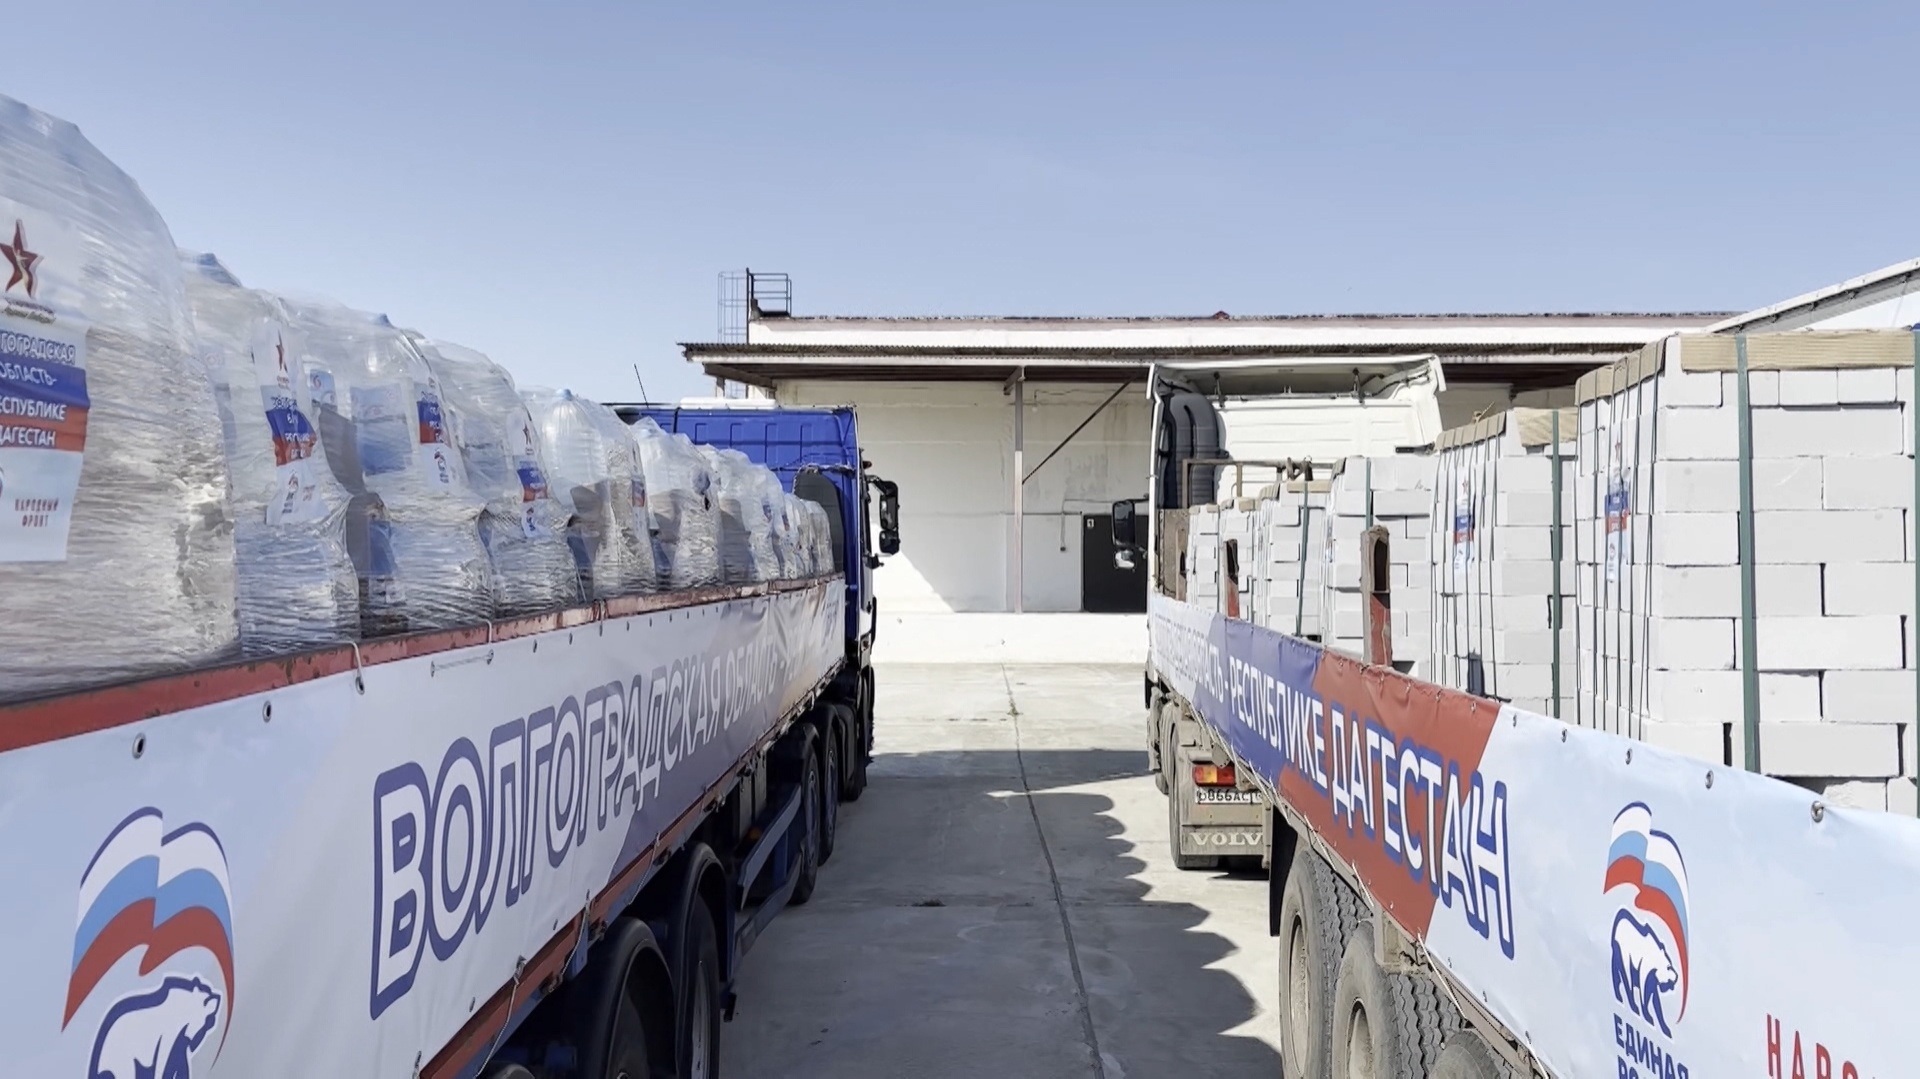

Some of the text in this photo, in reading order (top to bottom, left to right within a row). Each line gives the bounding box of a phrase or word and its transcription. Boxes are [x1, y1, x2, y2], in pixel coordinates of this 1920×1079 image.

[369, 653, 721, 1021] ВОЛГОГРАДСКАЯ
[1229, 654, 1328, 790] РЕСПУБЛИКЕ
[1330, 701, 1514, 960] ДАГЕСТАН
